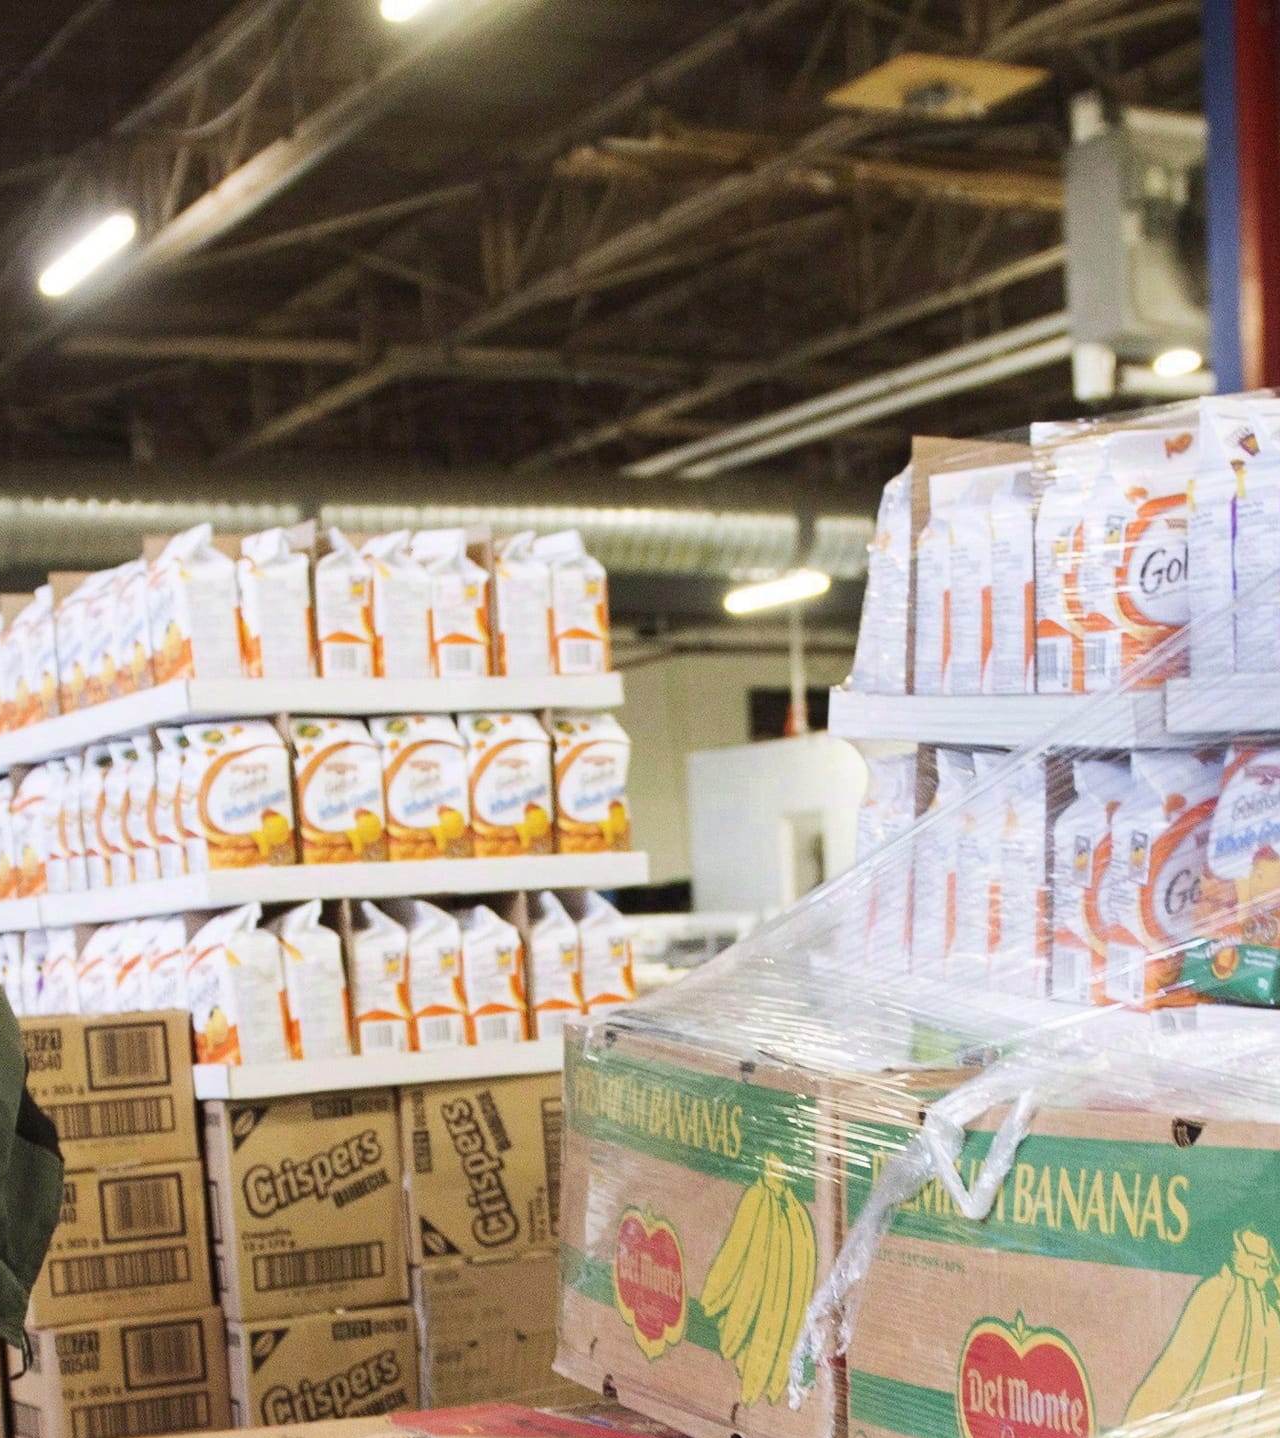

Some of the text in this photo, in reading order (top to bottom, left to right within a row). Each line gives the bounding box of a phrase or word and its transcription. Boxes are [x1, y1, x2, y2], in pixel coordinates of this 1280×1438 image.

[648, 1087, 742, 1159] BANANAS
[242, 1129, 381, 1219] Crispers
[441, 1098, 519, 1248] Crispers
[1013, 1164, 1189, 1243] BANANAS
[261, 1350, 403, 1427] Crispers
[968, 1369, 1084, 1437] Del Monte
